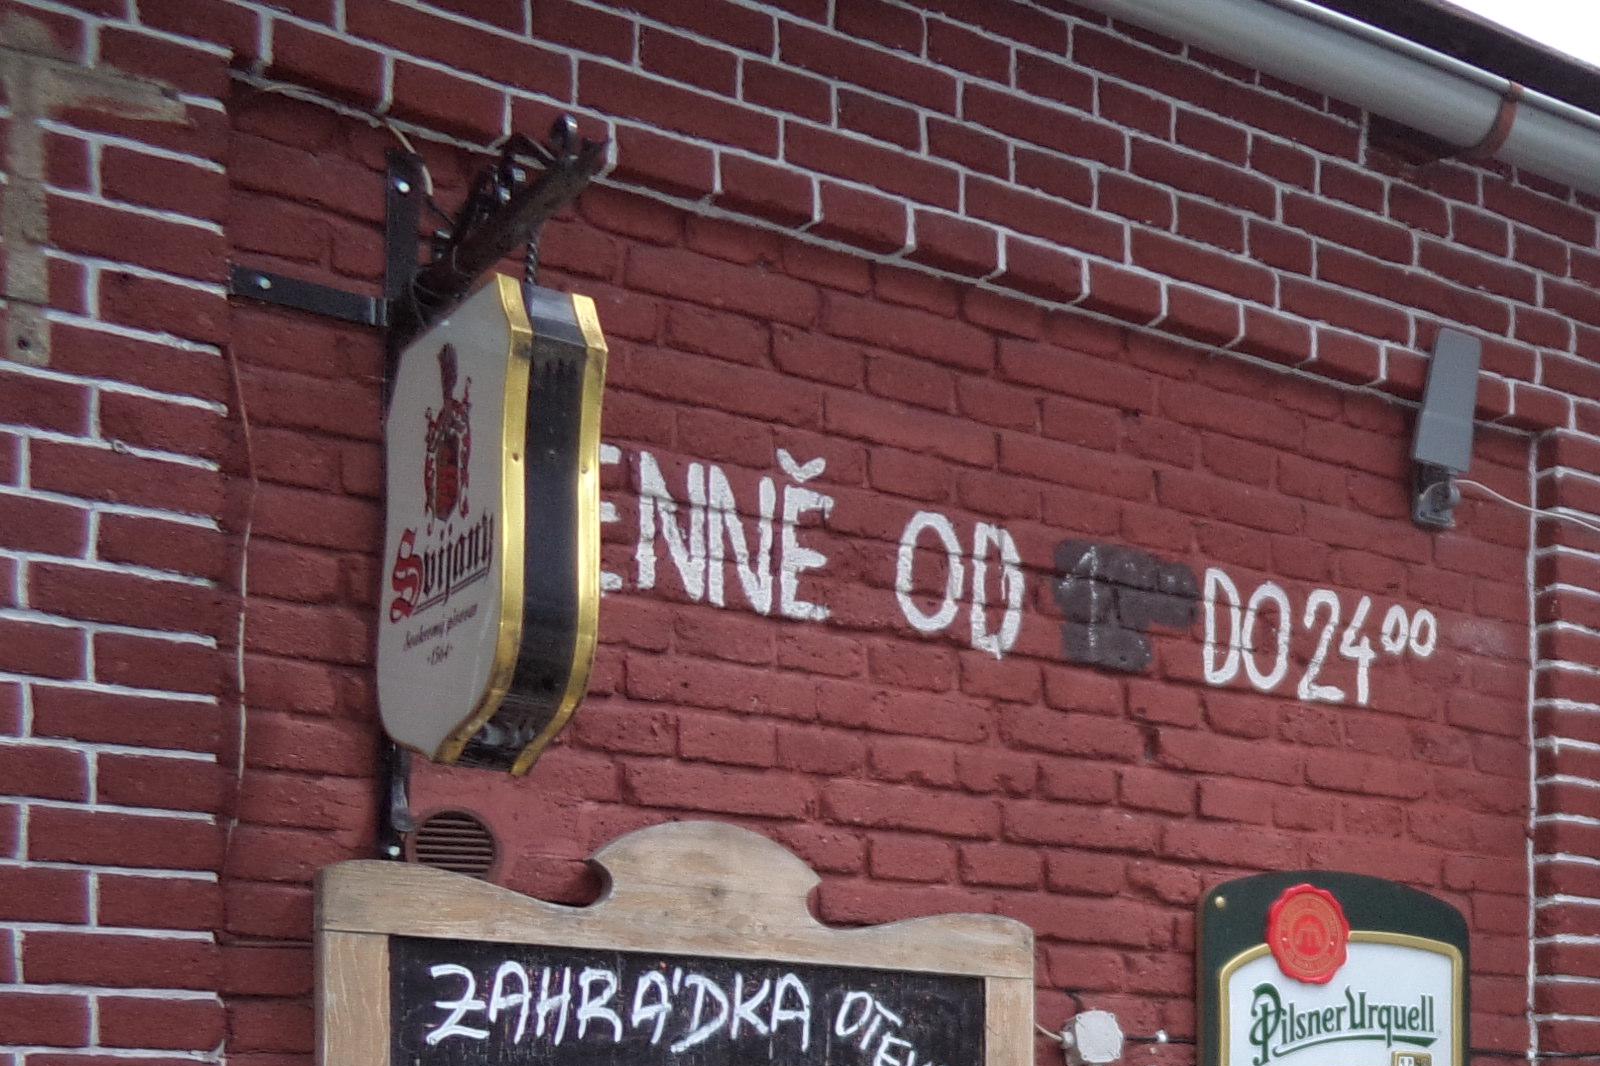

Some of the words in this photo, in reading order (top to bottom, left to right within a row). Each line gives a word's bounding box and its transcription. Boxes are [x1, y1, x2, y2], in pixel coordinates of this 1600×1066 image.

[389, 510, 494, 624] Svijany
[896, 512, 1025, 659] OD
[1249, 983, 1350, 1066] Pilsner
[1344, 985, 1435, 1048] Urquell
